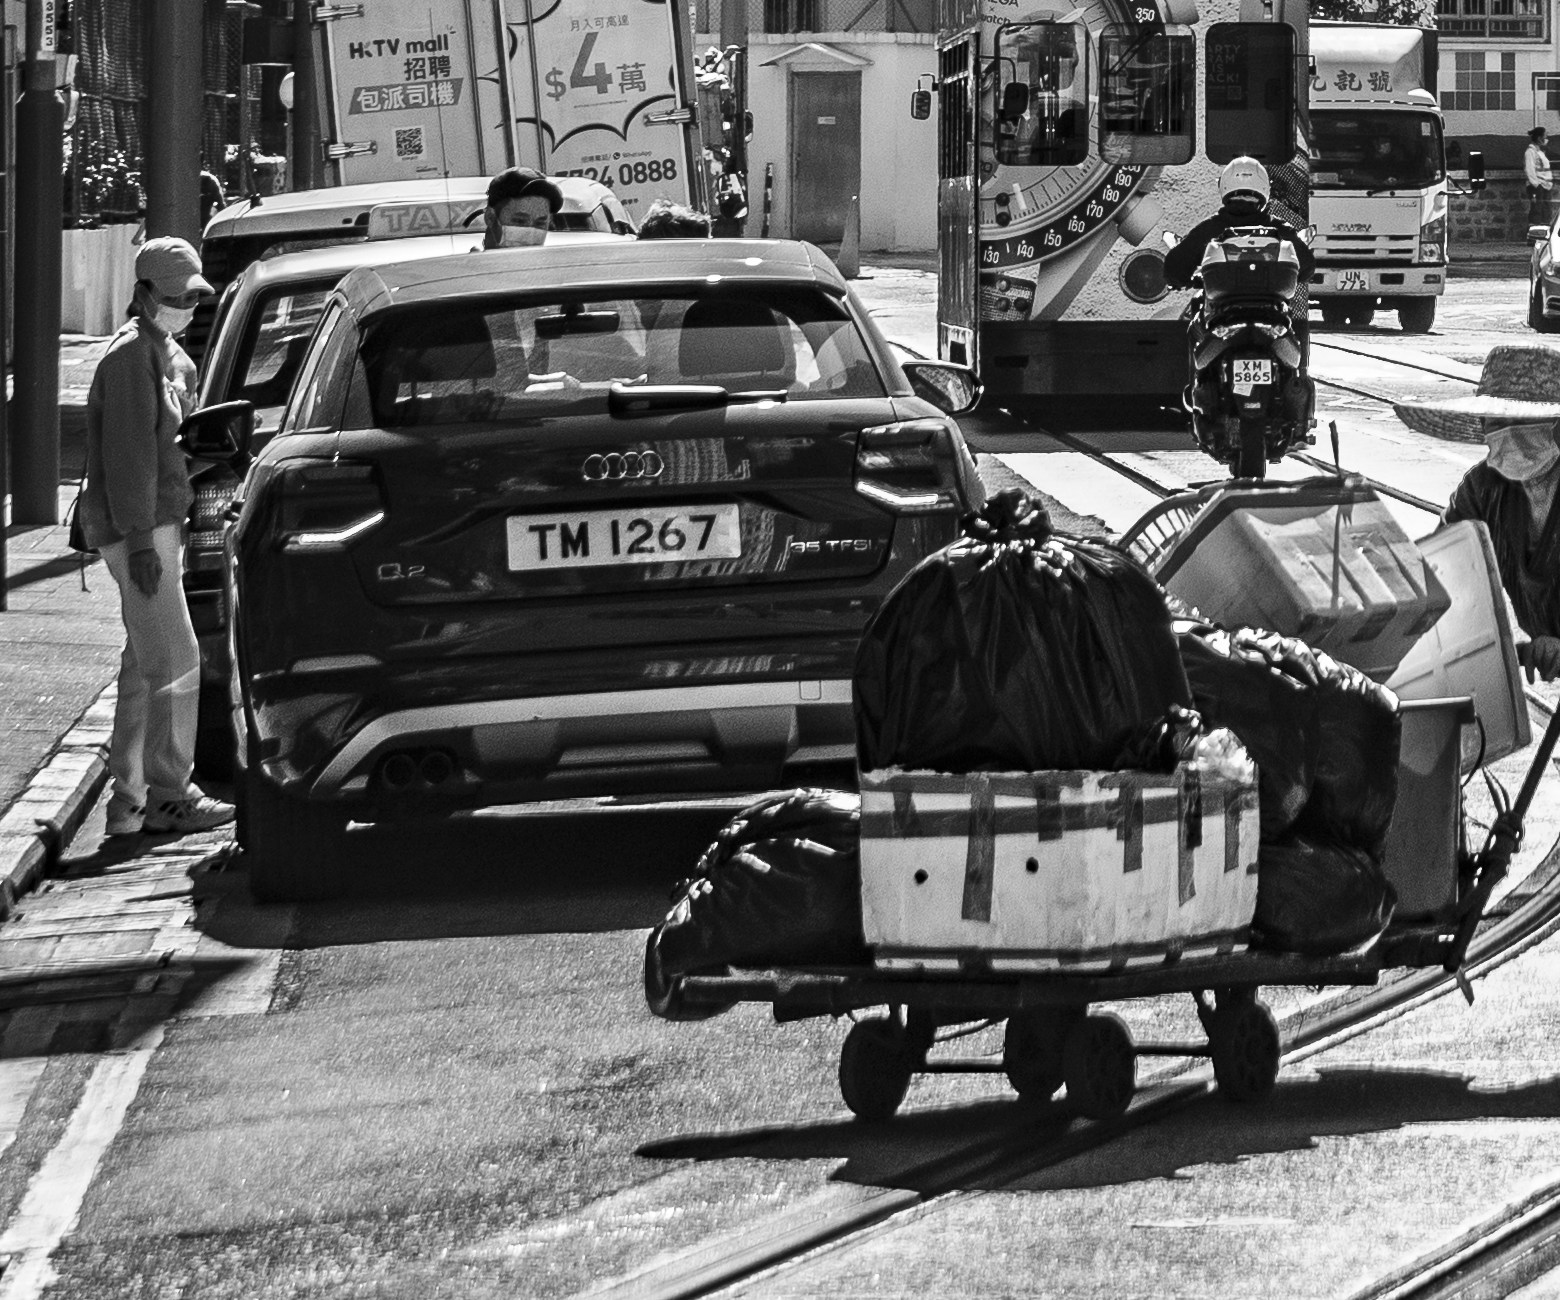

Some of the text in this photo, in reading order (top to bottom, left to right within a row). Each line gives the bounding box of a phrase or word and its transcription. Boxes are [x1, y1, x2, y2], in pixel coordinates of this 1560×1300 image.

[570, 14, 630, 32] 月入可高達
[1135, 7, 1156, 22] 350
[405, 33, 450, 54] mall
[403, 54, 452, 82] 招聘
[356, 81, 456, 112] 包派司機
[618, 158, 678, 186] 0888
[1115, 172, 1132, 187] 190
[1102, 187, 1120, 203] 180
[1086, 202, 1104, 219] 170
[1067, 218, 1085, 234] 160
[1044, 231, 1063, 248] 150
[983, 248, 1001, 265] 130
[1016, 241, 1035, 259] 140
[1242, 360, 1262, 371] XM
[1234, 371, 1271, 383] 5865
[528, 513, 717, 560] TM 1267
[825, 539, 872, 552] TFSI
[378, 562, 425, 581] Q2
